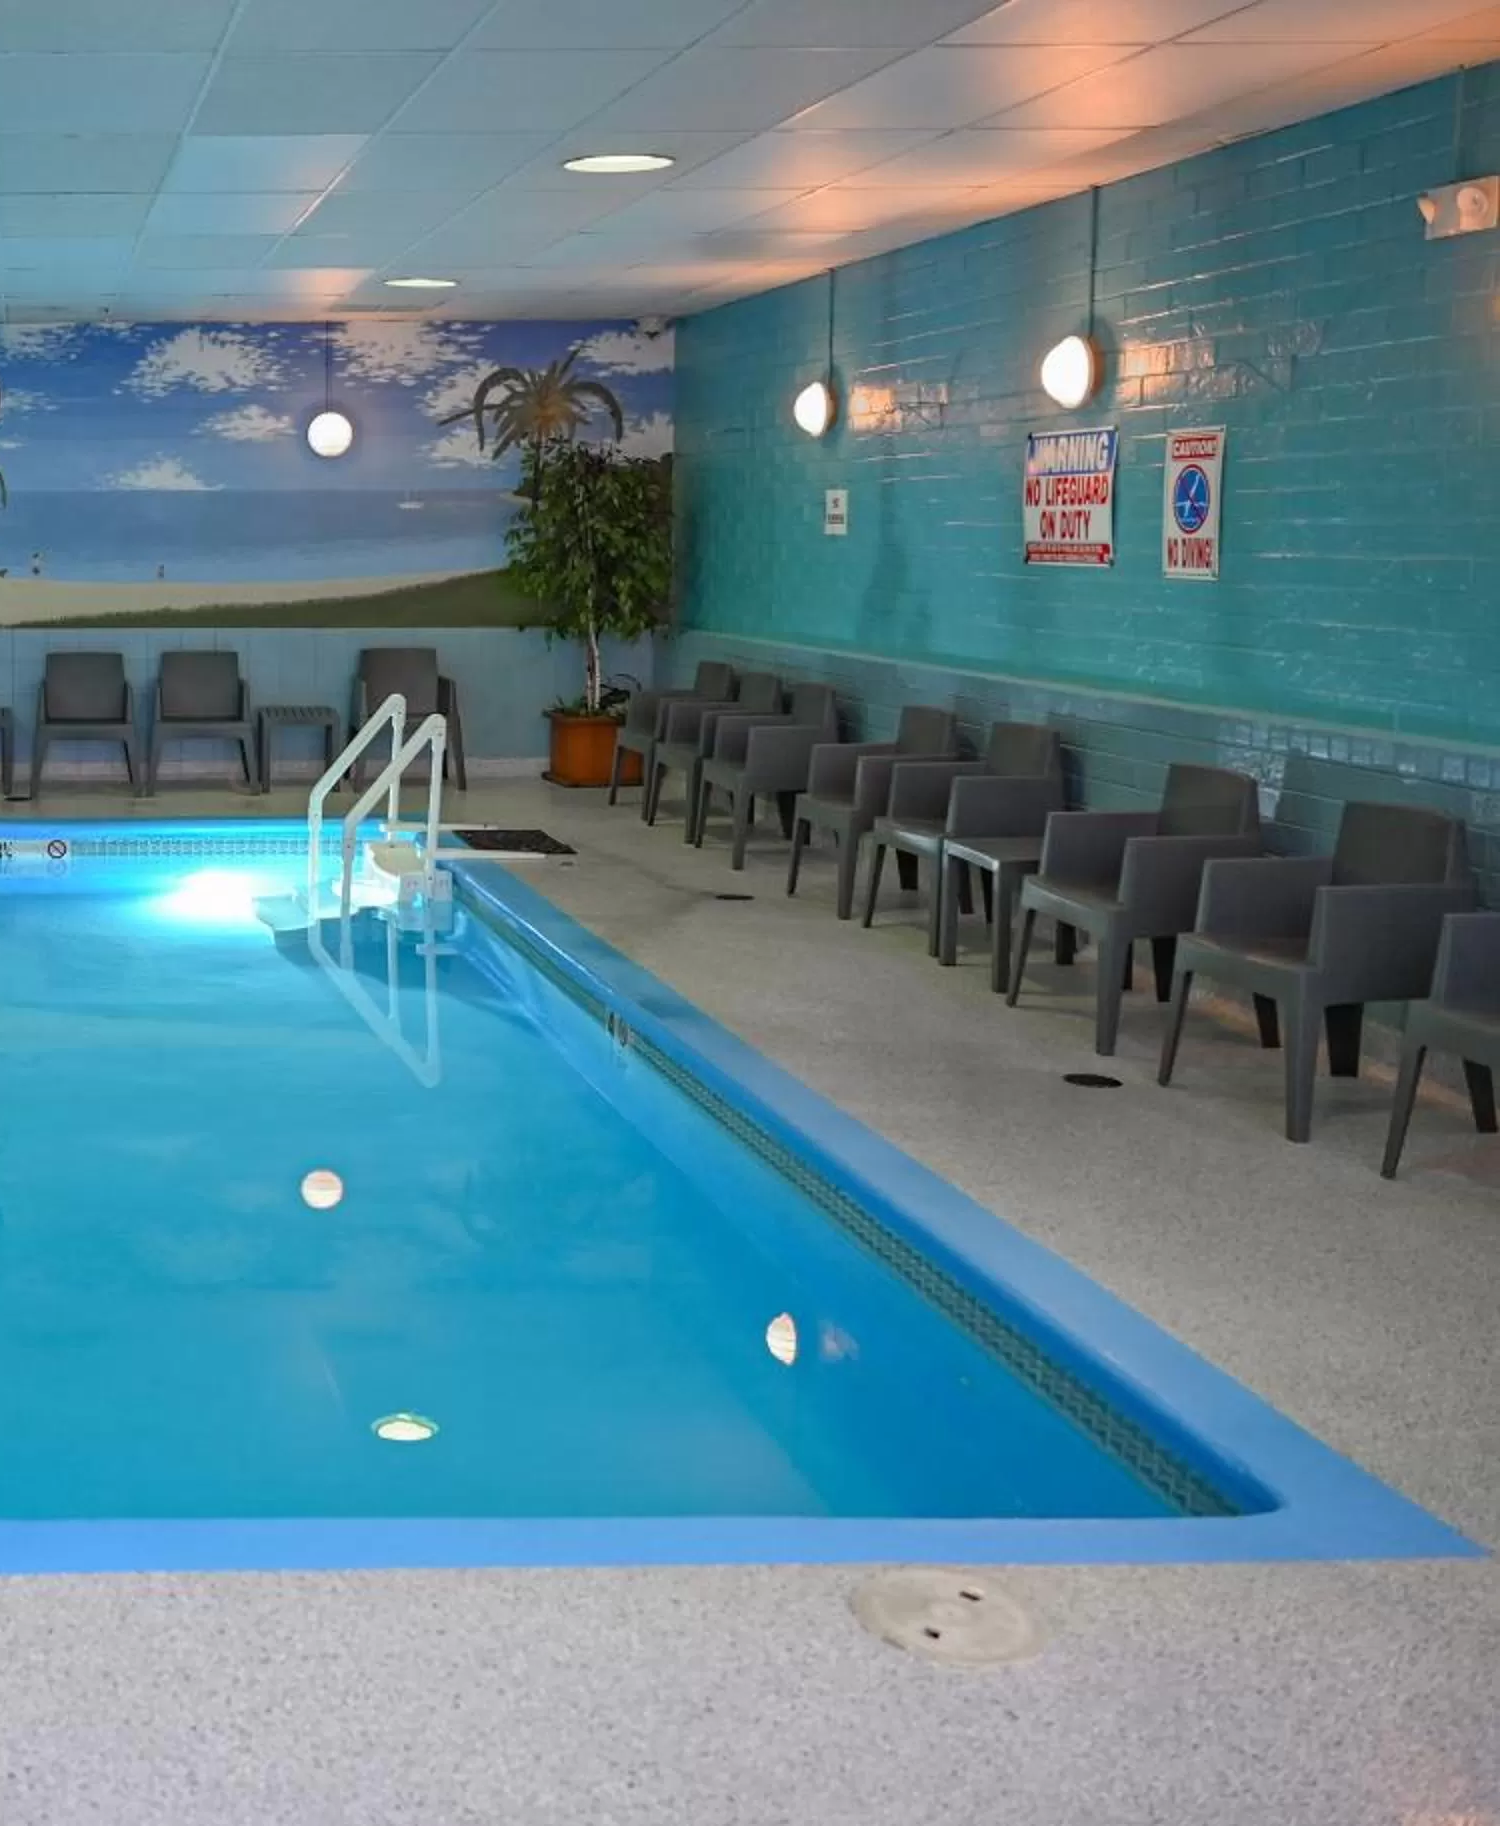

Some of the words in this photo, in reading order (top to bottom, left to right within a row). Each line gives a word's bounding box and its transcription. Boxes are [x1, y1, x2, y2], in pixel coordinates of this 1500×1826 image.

[1034, 431, 1109, 473] WARNING
[1026, 477, 1040, 507] NO
[1046, 475, 1109, 506] LIFEGUARD
[1040, 511, 1055, 539] ON
[1060, 510, 1090, 539] DUTY
